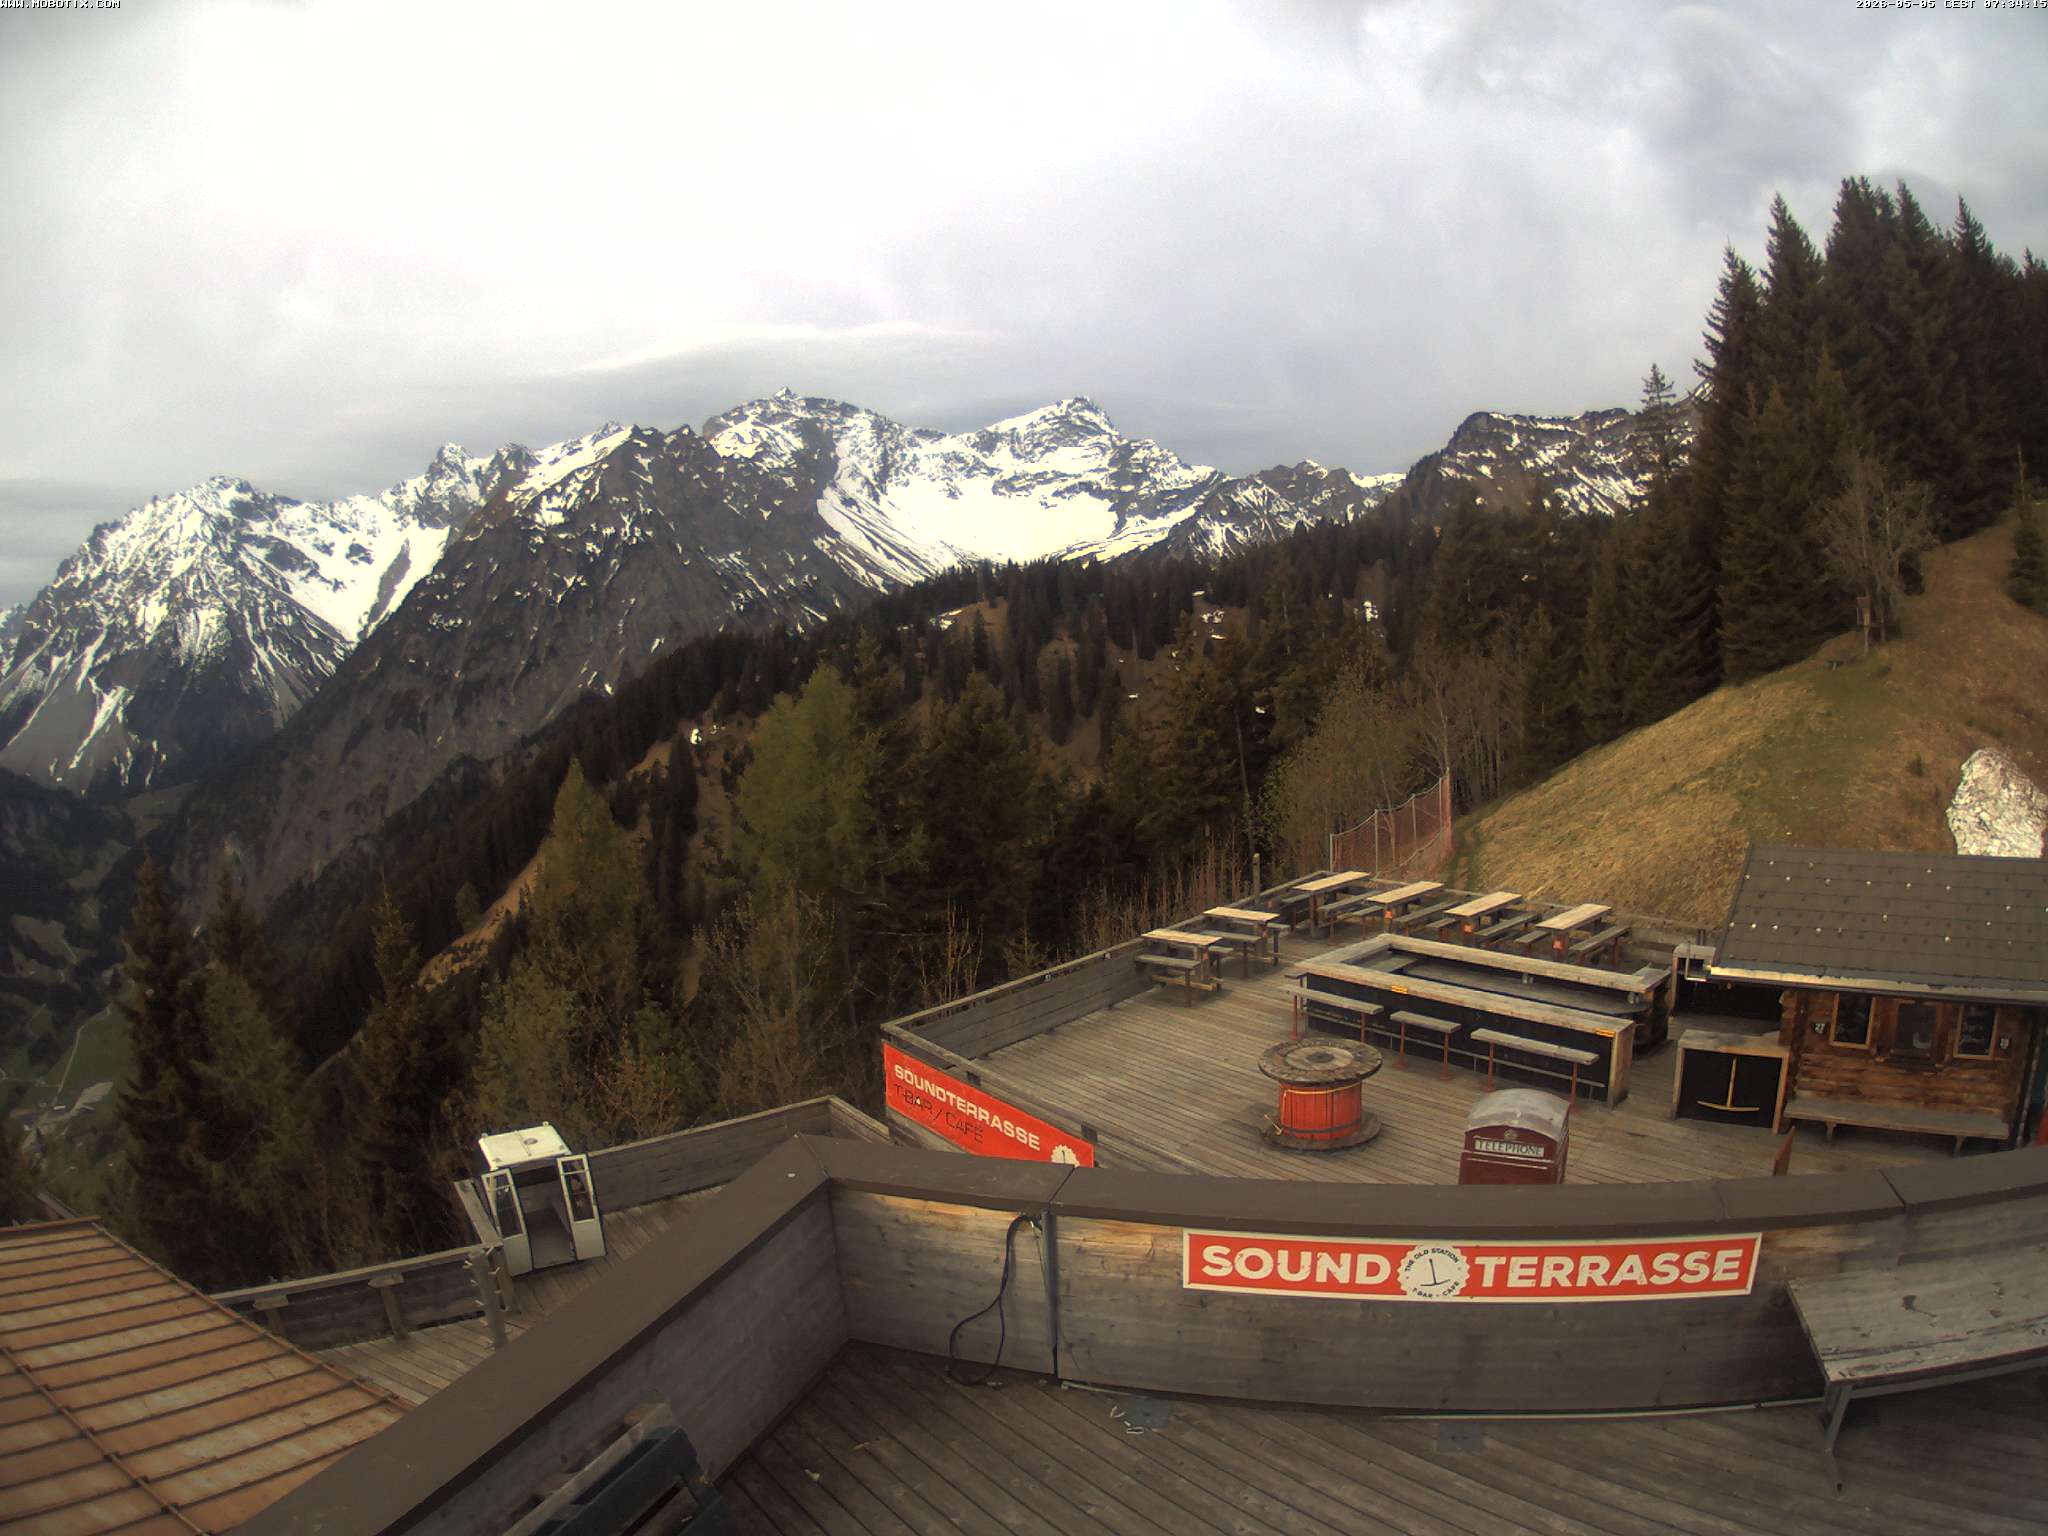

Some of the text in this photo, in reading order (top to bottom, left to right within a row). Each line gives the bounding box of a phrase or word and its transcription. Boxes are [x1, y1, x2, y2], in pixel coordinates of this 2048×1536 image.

[894, 1064, 1041, 1151] SOUNDTERRASSE
[1476, 1141, 1542, 1156] TELEPHONE
[1201, 1245, 1389, 1286] SOUND
[1414, 1249, 1430, 1260] OLD
[1431, 1248, 1459, 1263] STATION
[1475, 1249, 1744, 1288] TERRASSE
